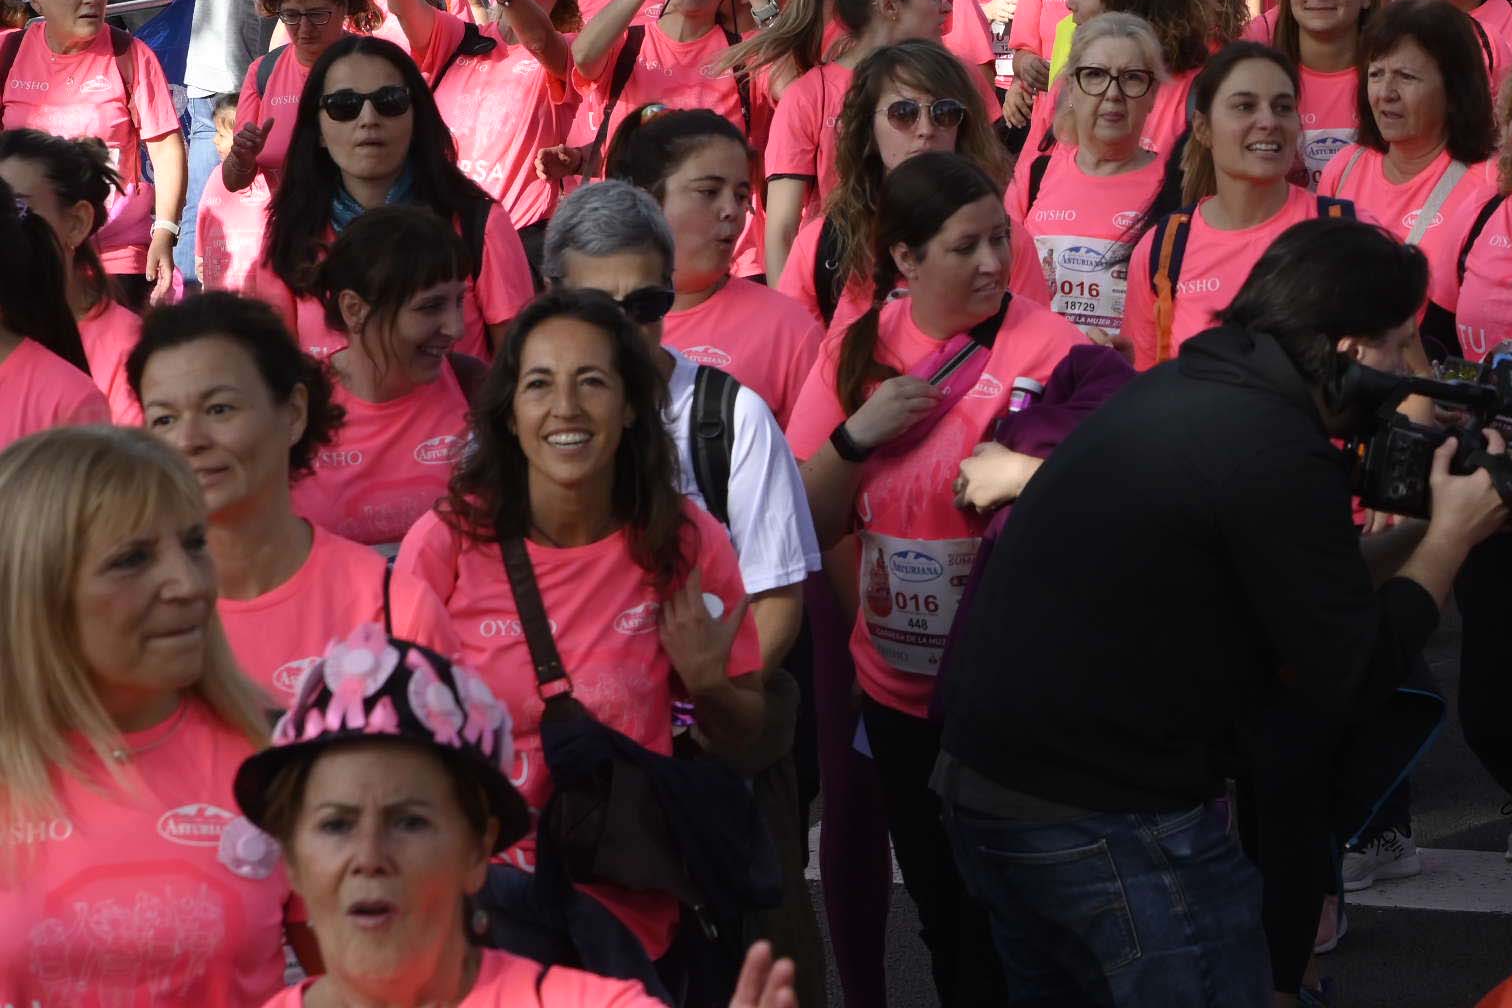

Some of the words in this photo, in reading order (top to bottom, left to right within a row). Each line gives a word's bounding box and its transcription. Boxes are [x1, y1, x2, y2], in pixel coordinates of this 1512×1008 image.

[10, 79, 50, 92] OYSHO
[1036, 208, 1077, 223] OYSHO
[1060, 279, 1101, 298] 016
[1063, 300, 1096, 312] 18729
[1086, 317, 1111, 327] MUJER
[1456, 324, 1487, 353] TU
[894, 592, 939, 613] 016
[479, 618, 558, 640] OYSO
[907, 617, 929, 632] 448
